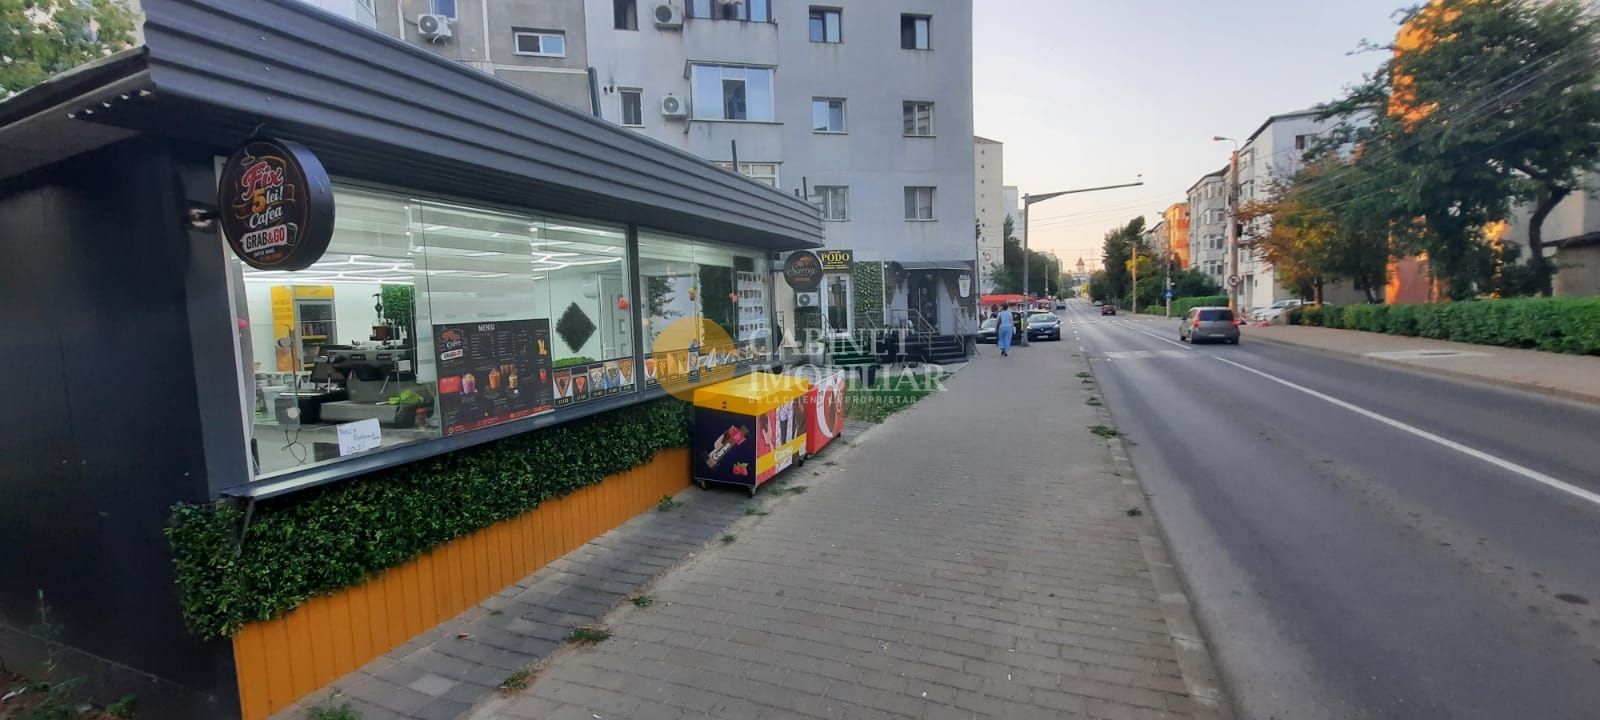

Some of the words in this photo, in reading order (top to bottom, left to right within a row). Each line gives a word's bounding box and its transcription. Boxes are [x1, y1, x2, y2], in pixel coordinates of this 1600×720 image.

[241, 161, 284, 201] Fix
[252, 188, 266, 212] 5
[266, 185, 284, 204] lei!
[249, 206, 283, 229] Cafea
[246, 226, 285, 250] GRAB&GO
[821, 252, 850, 262] PODO
